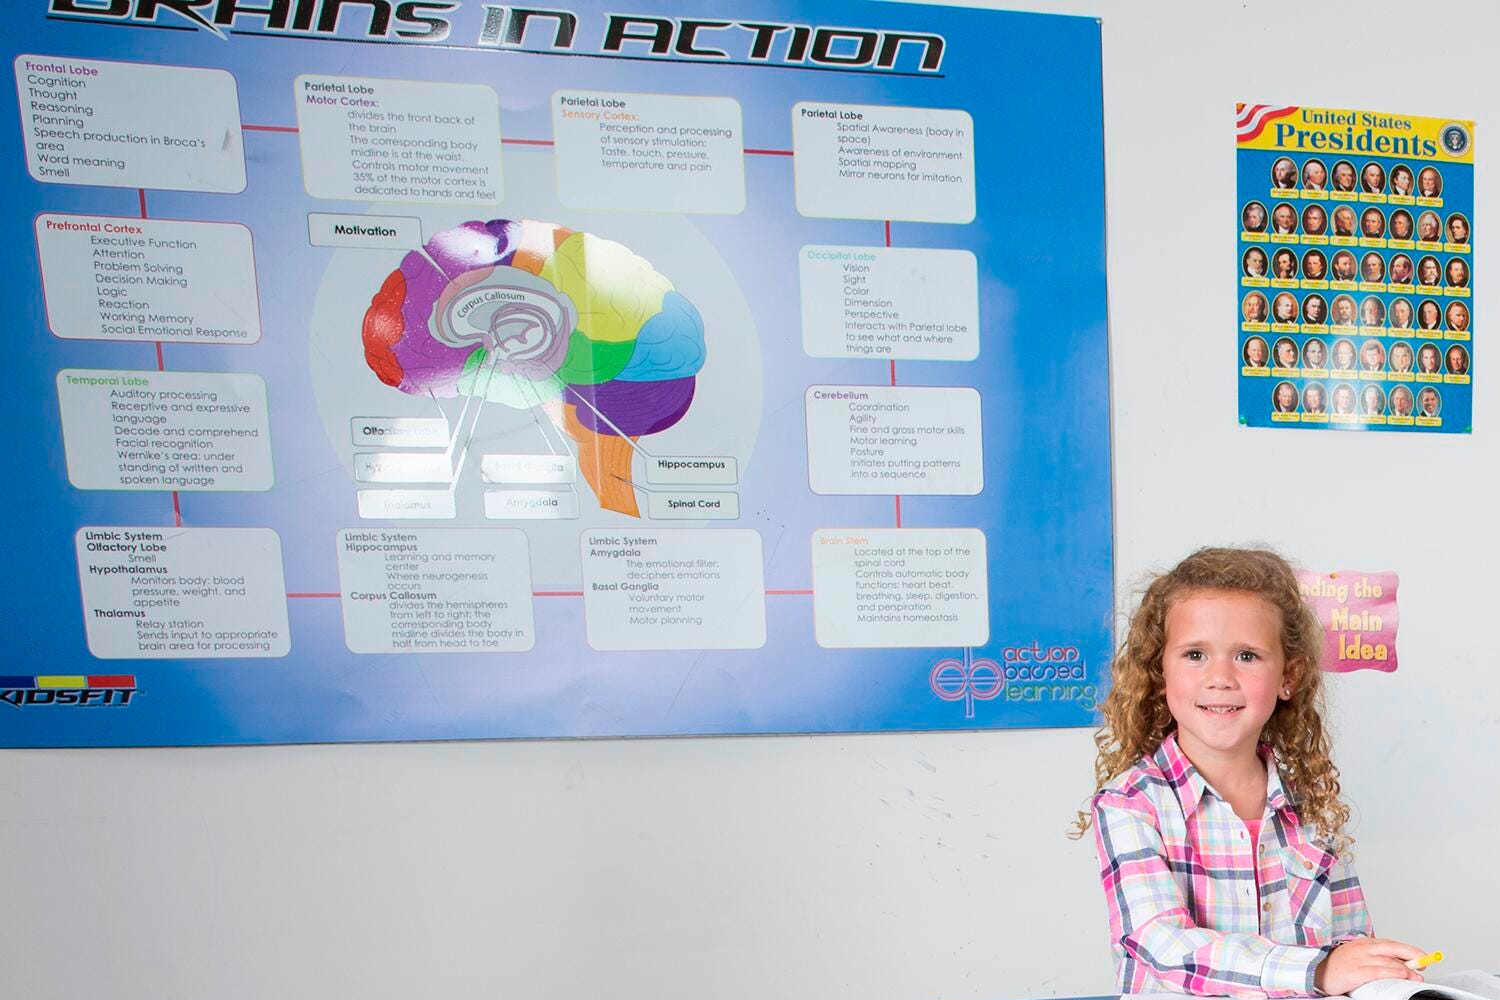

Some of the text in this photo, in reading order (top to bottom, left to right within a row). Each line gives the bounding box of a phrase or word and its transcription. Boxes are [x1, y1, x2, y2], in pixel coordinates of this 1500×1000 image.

[478, 4, 579, 49] IN
[600, 11, 945, 73] ACTION
[25, 61, 99, 76] Frontal Lobe
[27, 74, 87, 90] Cognition
[304, 81, 375, 95] Parietal Lobe
[28, 87, 77, 103] Thought
[306, 94, 378, 107] Motor Cortex:
[30, 100, 94, 117] Reasoning
[560, 96, 626, 109] Parietal Lobe
[561, 109, 640, 122] Sensory Cortex:
[801, 108, 863, 121] Parietal Lobe
[1302, 109, 1412, 130] United States
[32, 114, 85, 130] Planning
[836, 122, 964, 138] Spatial Awareness (body in
[33, 127, 206, 148] Speech production in Broca's
[837, 135, 871, 146] space)
[1275, 123, 1437, 157] Presidents
[35, 142, 65, 152] area
[37, 153, 126, 170] Word meaning
[38, 166, 70, 177] Smell
[46, 220, 143, 234] Prefrontal Cortex
[334, 225, 397, 237] Motivation
[90, 235, 197, 249] Executive Function
[92, 248, 145, 260] Attention
[807, 250, 877, 262] Occipital Lobe
[93, 260, 184, 276] Problem Solving
[842, 263, 870, 273] Vision
[95, 273, 188, 289] Decision Making
[843, 275, 866, 285] Sight
[96, 286, 128, 299] Logic
[843, 286, 870, 296] Color
[98, 298, 150, 310] Reaction
[456, 291, 525, 318] Corpus Callosum
[844, 297, 893, 308] Dimension
[99, 312, 194, 325] Working Memory
[844, 309, 900, 320] Perspective
[101, 323, 247, 338] Social Emotional Response
[65, 375, 149, 386] Temporal Lobe
[110, 389, 218, 402] Auditory processing
[813, 391, 869, 400] Cerebellum
[848, 402, 910, 412] Coordination
[849, 414, 877, 424] Agility
[115, 437, 214, 450] Facial recognition
[850, 436, 918, 447] Motor learning
[850, 447, 885, 457] Posture
[658, 460, 726, 470] Hippocampus
[668, 499, 721, 509] Spinal Cord
[85, 531, 163, 543] Limbic System
[344, 532, 418, 543] Limbic System
[589, 536, 658, 547] Limbic System
[86, 542, 167, 554] Olfactory Lobe
[345, 541, 418, 553] Hippocampus
[128, 552, 157, 563] Smell
[590, 548, 641, 559] Amygdala
[89, 565, 168, 575] Hypothalamus
[592, 582, 659, 593] Basal Ganglia
[1300, 576, 1383, 603] nding the
[350, 591, 437, 601] Corpus Callosum
[93, 609, 146, 618] Thalamus
[1331, 607, 1383, 631] Main
[1003, 640, 1080, 662] action
[1339, 633, 1388, 660] Idea
[1004, 683, 1097, 710] learning
